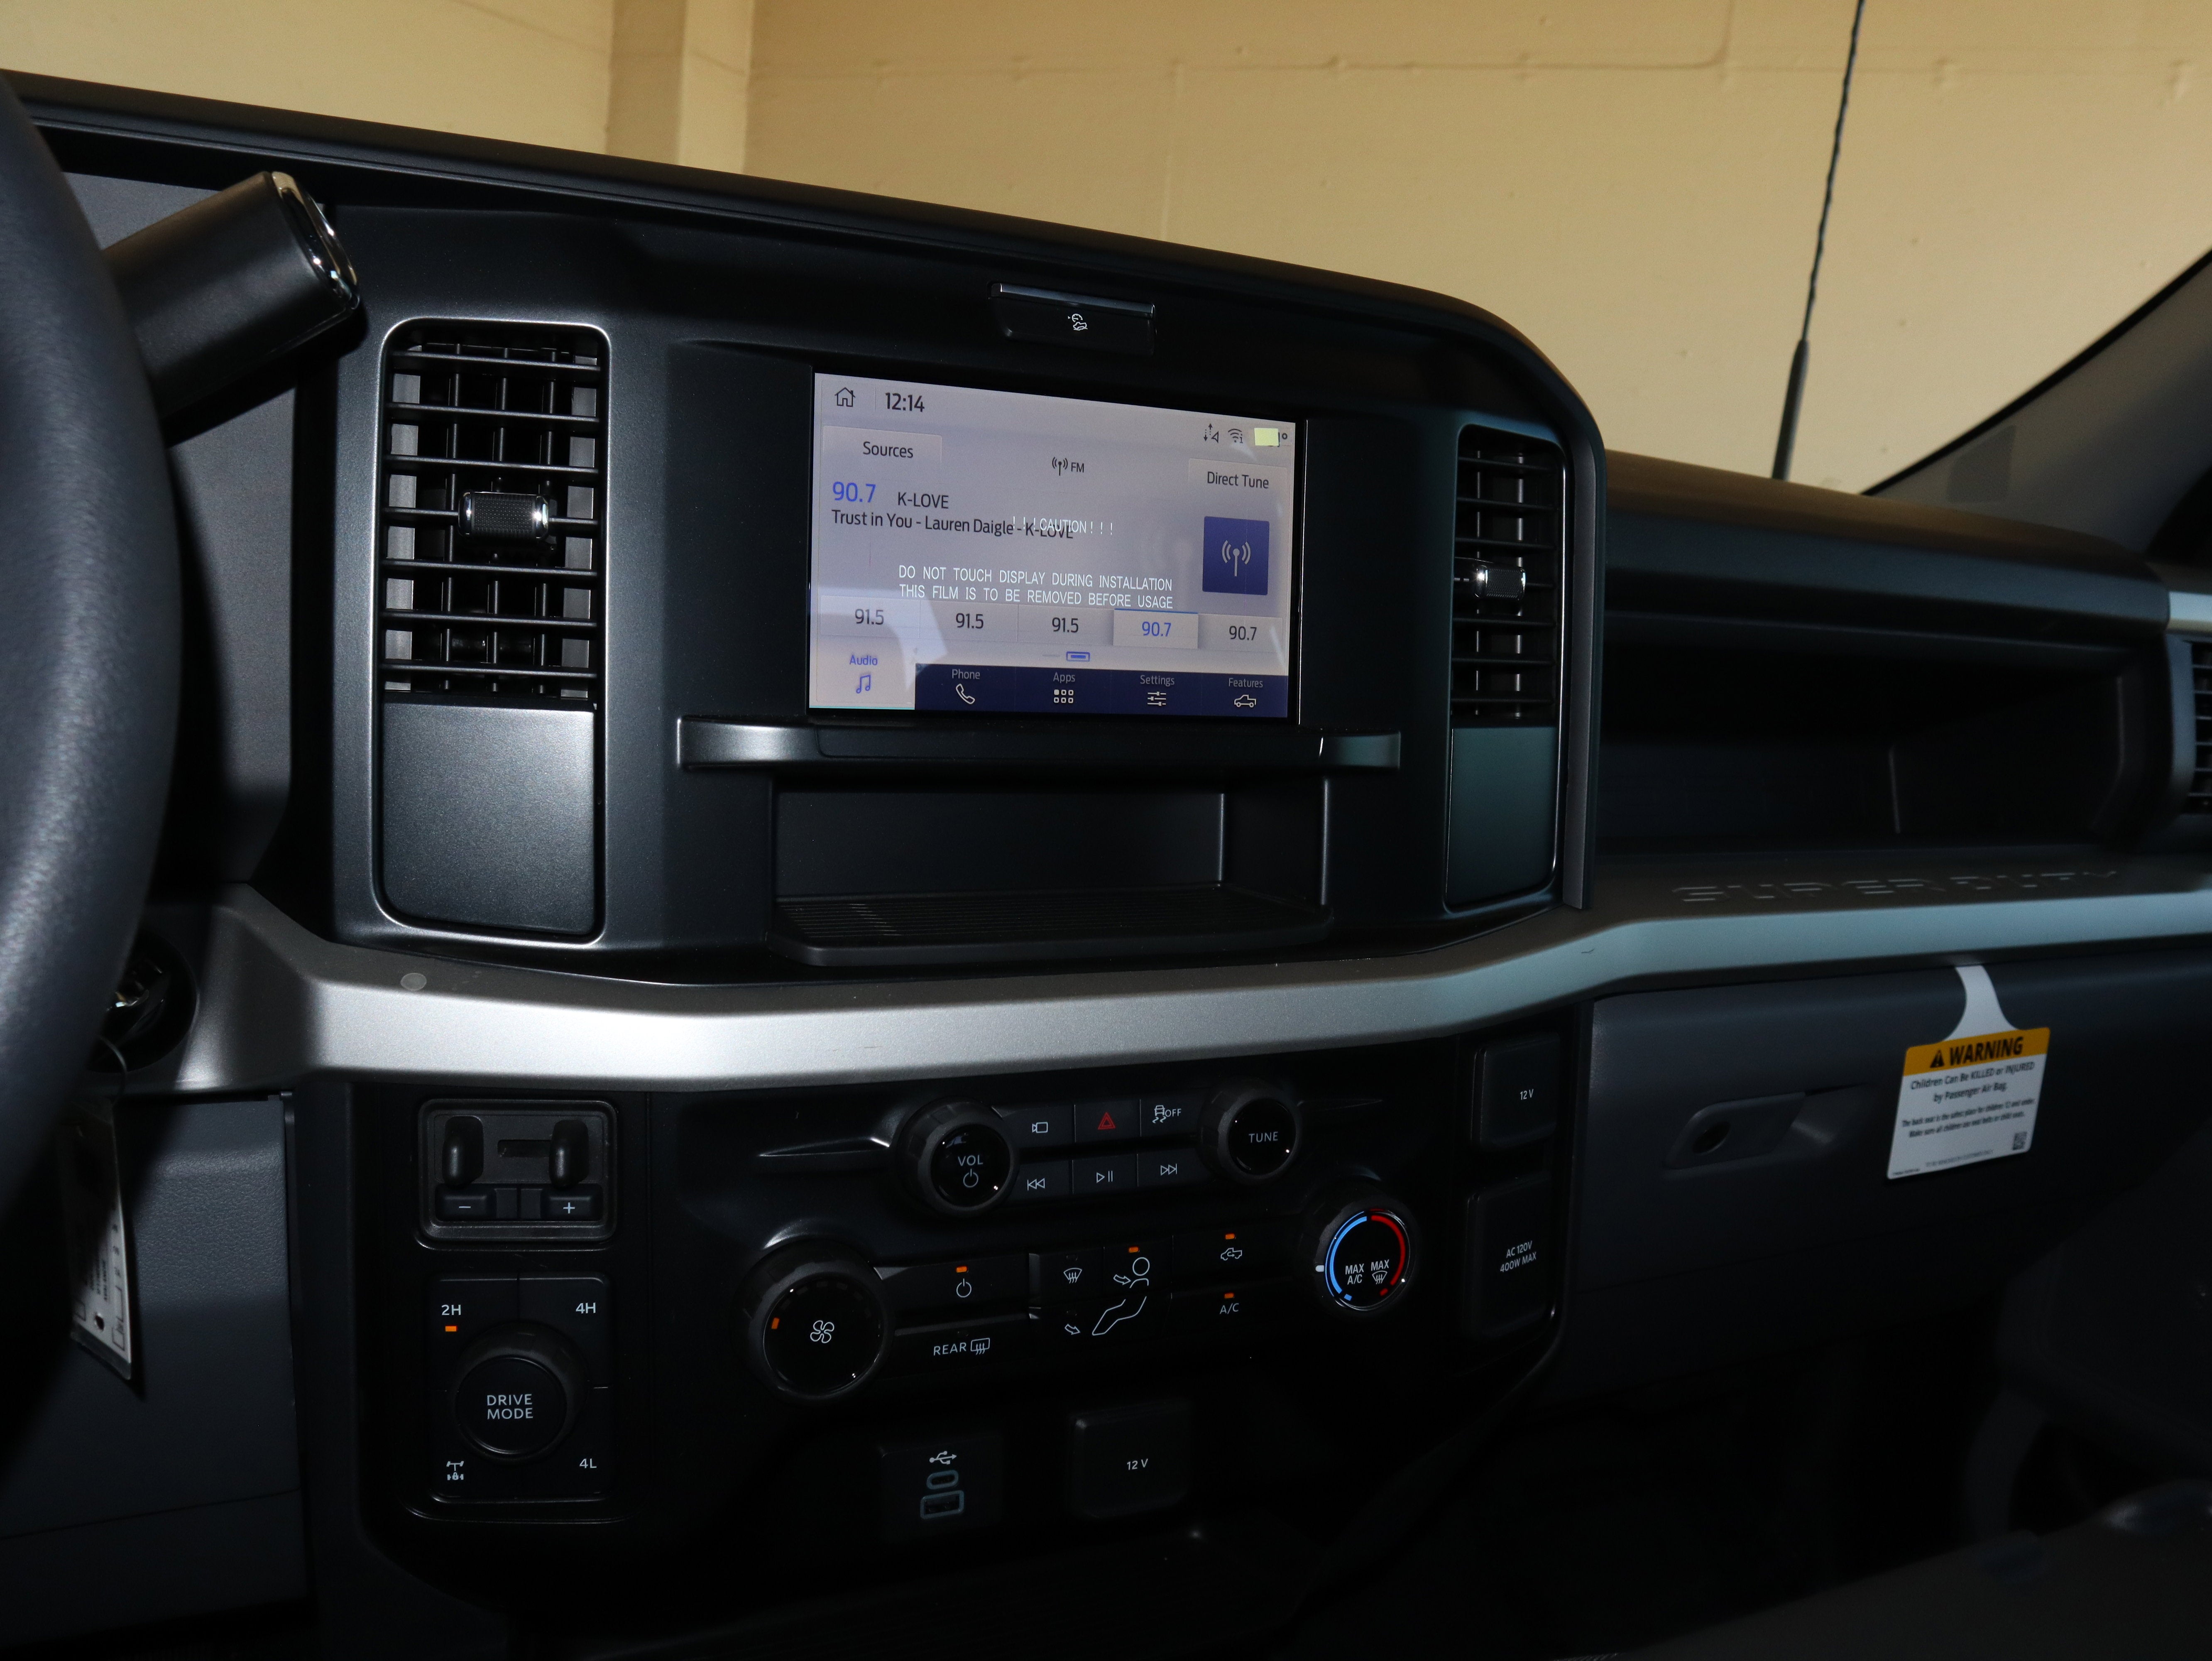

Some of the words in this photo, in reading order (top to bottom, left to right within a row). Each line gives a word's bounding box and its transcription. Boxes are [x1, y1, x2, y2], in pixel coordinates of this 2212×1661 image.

[885, 392, 925, 412] 12:14
[863, 441, 914, 458] Sources
[1071, 463, 1084, 473] FM
[1207, 471, 1238, 486] Direct
[1242, 474, 1269, 489] Tune
[832, 481, 876, 503] 90.7
[898, 492, 949, 509] K-LOVE
[832, 509, 866, 526] Trust
[871, 512, 883, 527] in
[886, 513, 912, 528] You
[925, 515, 970, 532] Lauren
[974, 519, 1014, 537] Daigle
[1040, 518, 1087, 534] CAUTION
[899, 565, 915, 578] DO
[923, 566, 946, 580] NOT
[953, 567, 992, 582] TOUCH
[999, 570, 1045, 585] DISPLAY
[1052, 572, 1093, 588] DURING
[1099, 575, 1172, 591] INSTALLATION
[899, 584, 925, 598] THIS
[932, 586, 958, 599] FILM
[966, 587, 976, 600] IS
[983, 588, 998, 601] TO
[1006, 589, 1020, 602] BE
[1028, 590, 1082, 605] REMOVED
[1089, 593, 1131, 607] BEFORE
[1138, 595, 1173, 609] USAGE
[855, 609, 884, 625] 91.5
[956, 613, 984, 629] 91.5
[1052, 617, 1079, 633] 91.5
[1142, 621, 1172, 637] 90.7
[1228, 625, 1258, 641] 90.7
[849, 655, 878, 666] Audio
[952, 669, 981, 680] Phone
[1053, 672, 1076, 684] Apps
[1140, 675, 1175, 686] Settings
[1228, 678, 1263, 688] Features
[1949, 1037, 2024, 1066] WARNING
[1911, 1078, 1943, 1090] Children
[1945, 1075, 1959, 1084] Can
[1961, 1073, 1969, 1082] Be
[1971, 1068, 1994, 1079] KILLED
[2006, 1061, 2035, 1075] INJURED
[1933, 1093, 1943, 1104] by
[1945, 1087, 1980, 1100] Passenger
[1982, 1084, 1992, 1093] Air
[1165, 1108, 1182, 1118] OFF
[1248, 1131, 1279, 1143] TUNE
[958, 1155, 984, 1166] VOL
[1506, 1247, 1515, 1259] AC
[1517, 1240, 1533, 1255] 120V
[1345, 1263, 1364, 1275] MAX
[1371, 1259, 1390, 1271] MAX
[1500, 1259, 1520, 1273] 400W
[1522, 1252, 1537, 1264] MAX
[1347, 1273, 1363, 1285] A/C
[441, 1304, 462, 1316] 2H
[575, 1302, 596, 1314] 4H
[1219, 1303, 1239, 1315] A/C
[933, 1341, 967, 1356] REAR
[487, 1393, 533, 1406] DRIVE
[487, 1408, 533, 1420] MODE
[579, 1458, 597, 1469] 4L
